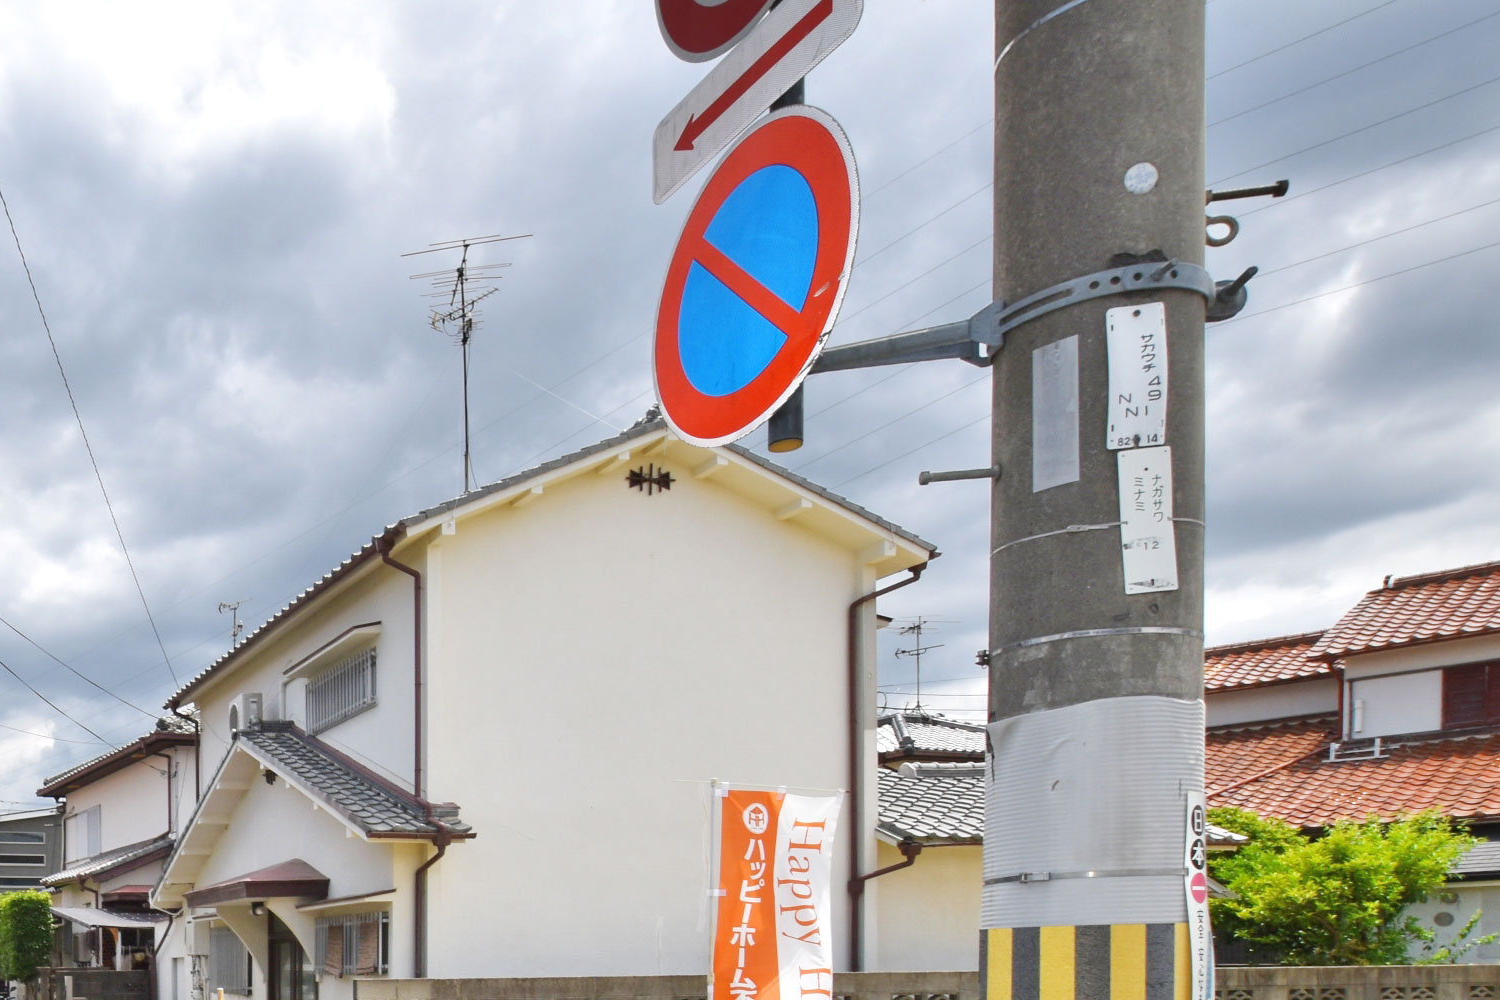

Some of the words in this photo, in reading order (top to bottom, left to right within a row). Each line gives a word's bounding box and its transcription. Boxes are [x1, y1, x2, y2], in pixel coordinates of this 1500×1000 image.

[1140, 333, 1157, 374] サカウチ
[1147, 375, 1162, 402] 49
[1116, 437, 1131, 446] 82
[1146, 433, 1159, 443] 14
[1134, 477, 1146, 512] ミナミ
[1151, 474, 1164, 523] ナガサワ
[777, 817, 827, 947] Happy
